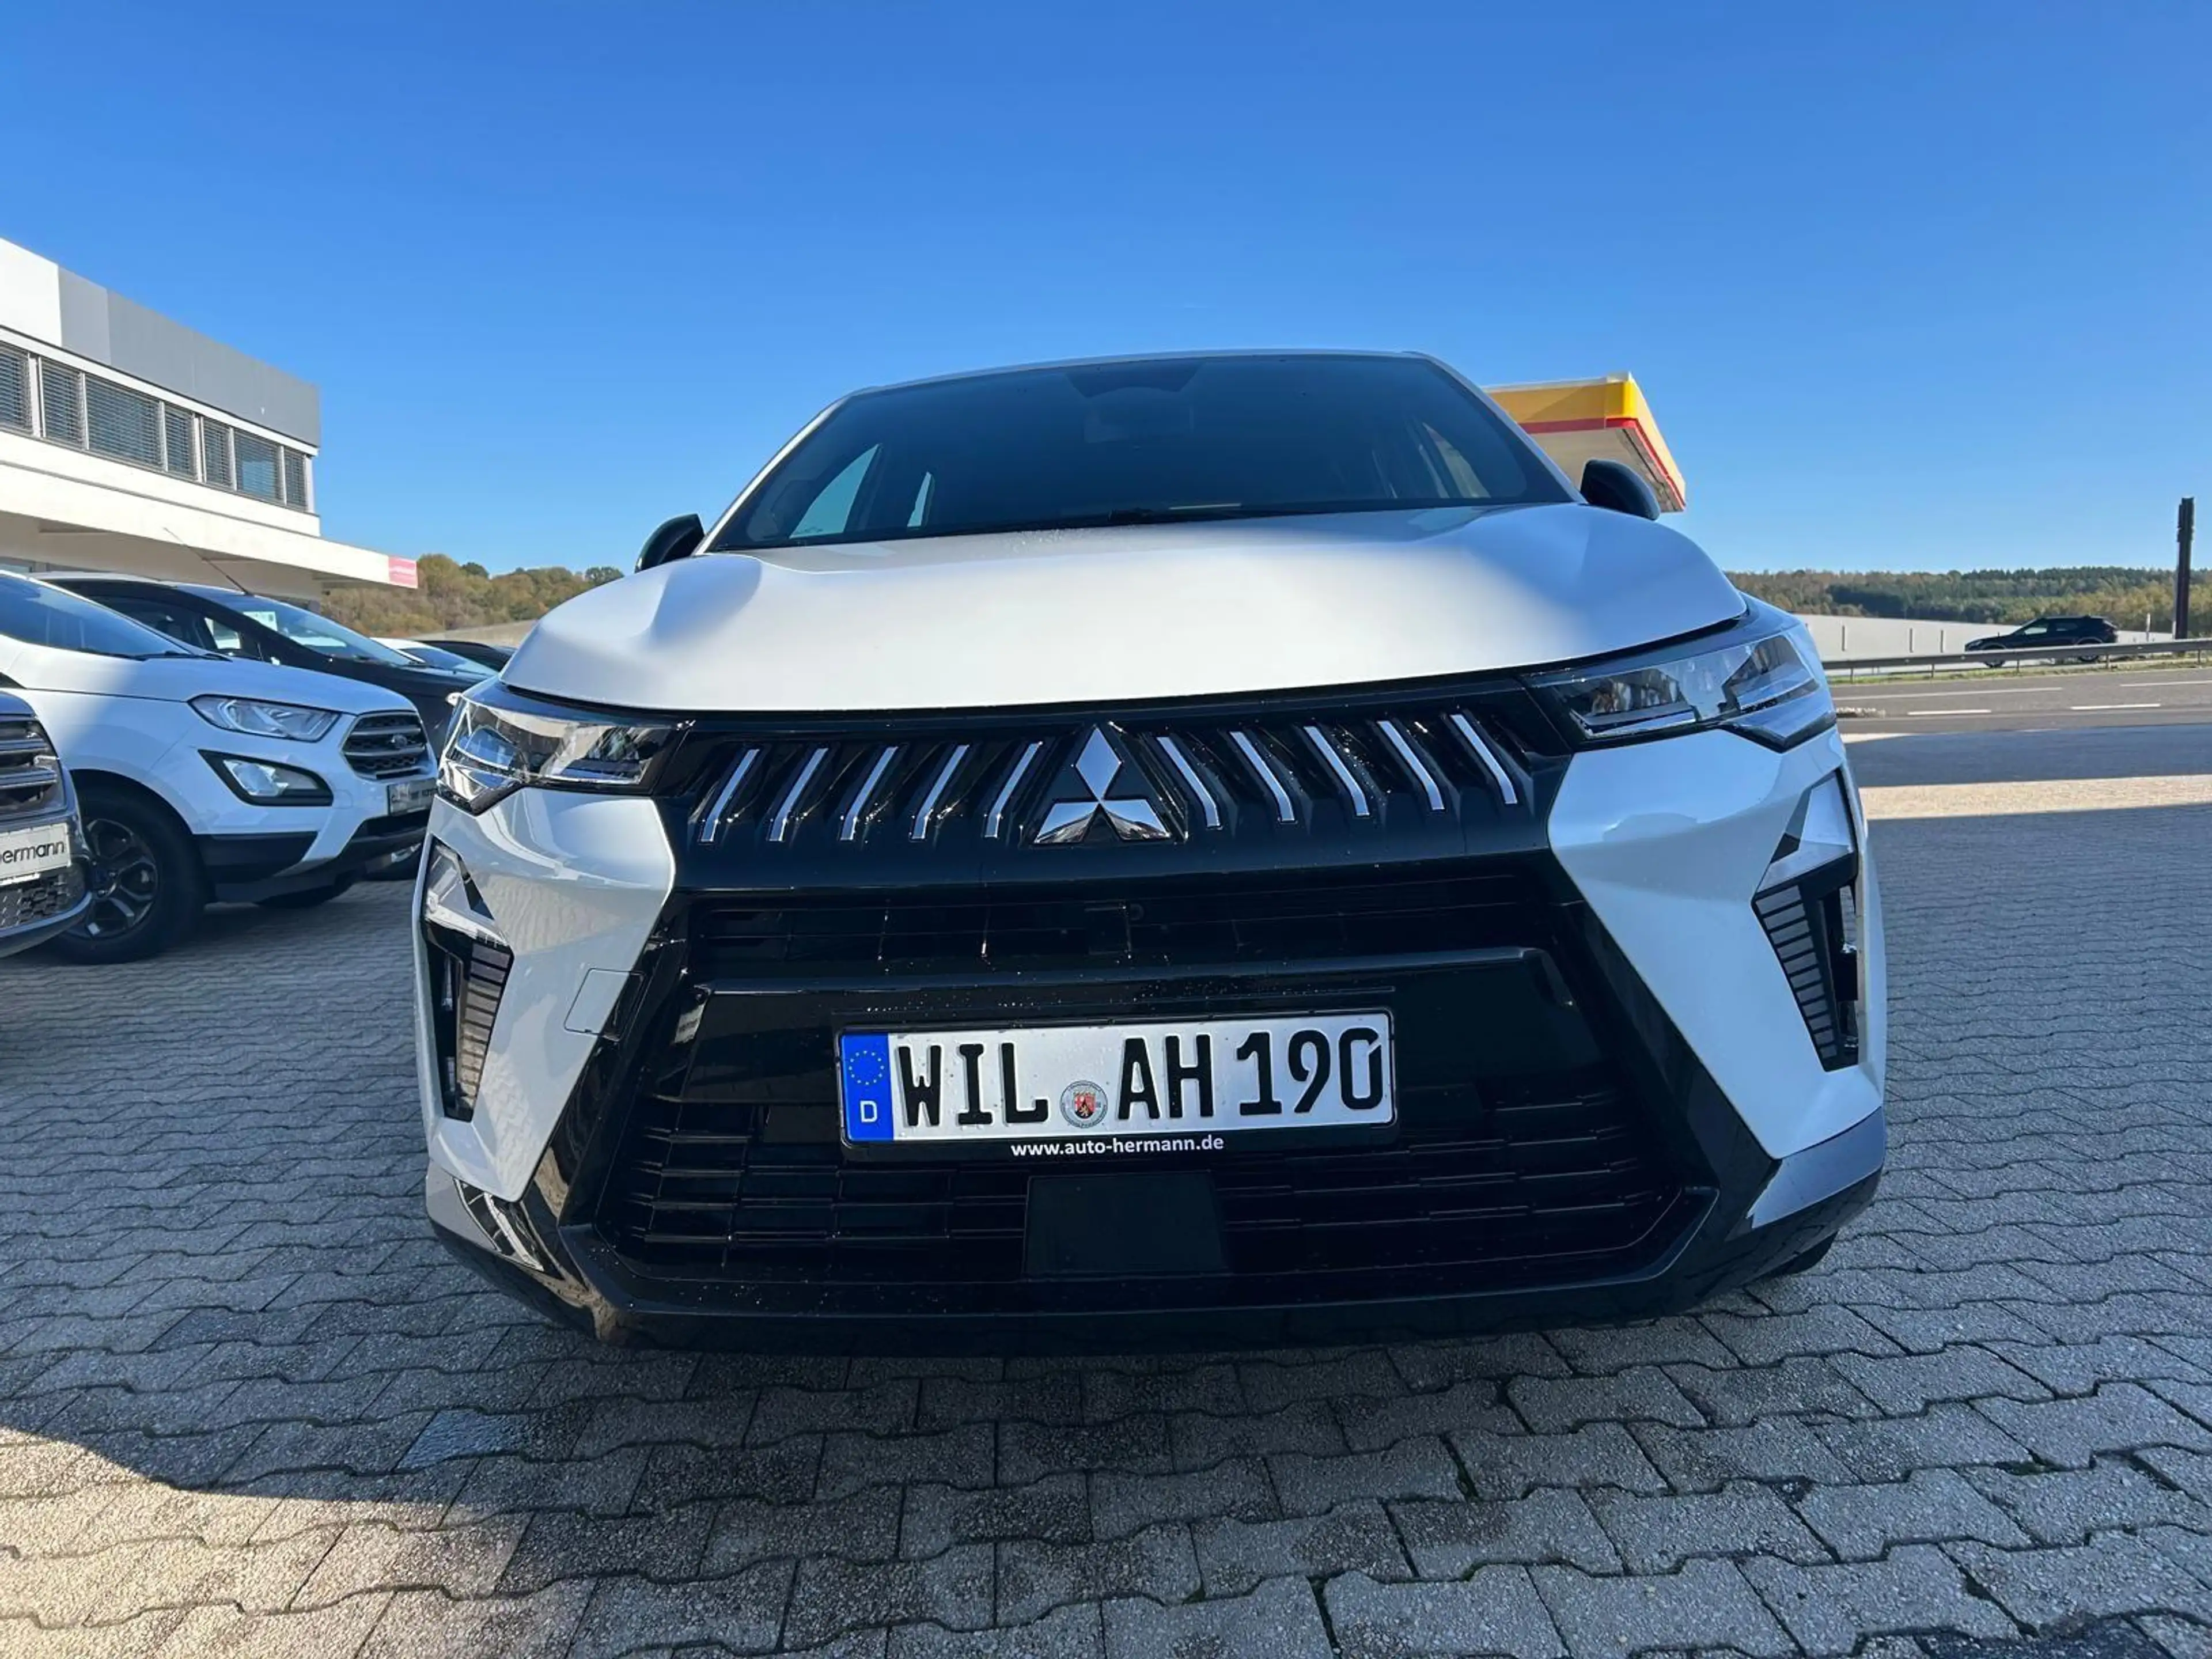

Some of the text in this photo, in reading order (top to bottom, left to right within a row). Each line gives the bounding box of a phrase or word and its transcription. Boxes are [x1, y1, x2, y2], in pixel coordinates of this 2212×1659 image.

[0, 840, 65, 863] ermann
[897, 1041, 1050, 1127] WIL
[1117, 1033, 1215, 1120] AH
[1236, 1027, 1383, 1116] 190
[859, 1100, 878, 1123] D
[1010, 1134, 1225, 1157] www.auto-hermann.de
